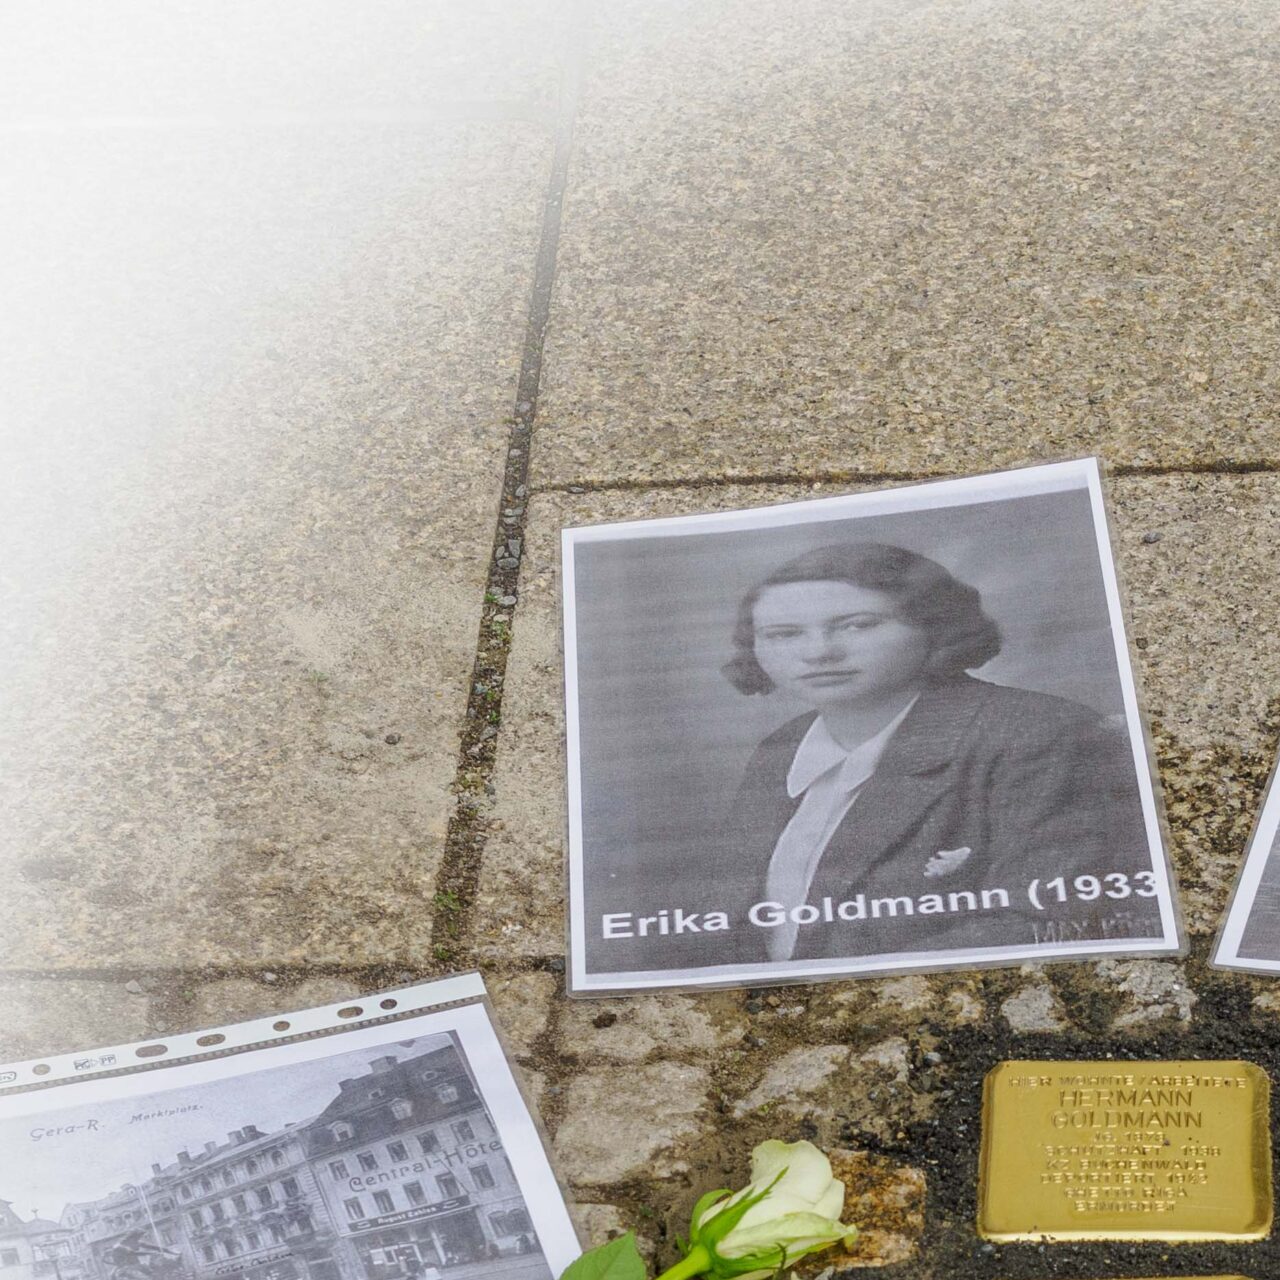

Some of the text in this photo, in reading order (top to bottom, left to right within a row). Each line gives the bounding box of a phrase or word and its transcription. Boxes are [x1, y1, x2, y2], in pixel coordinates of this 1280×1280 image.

[601, 906, 729, 939] Erika
[748, 888, 1009, 927] Goldmann
[1009, 1076, 1052, 1088] HIER
[1058, 1088, 1192, 1107] HERMANN
[1051, 1110, 1203, 1129] GOLDMANN
[1045, 1145, 1221, 1157] SCHUTZHAFT 1938
[1047, 1159, 1207, 1171] KZ BUCHENWALD
[1041, 1172, 1156, 1185] DEPORTIERT
[1064, 1186, 1188, 1198] GHETTO RIGA
[1075, 1200, 1176, 1212] ERMORDET
